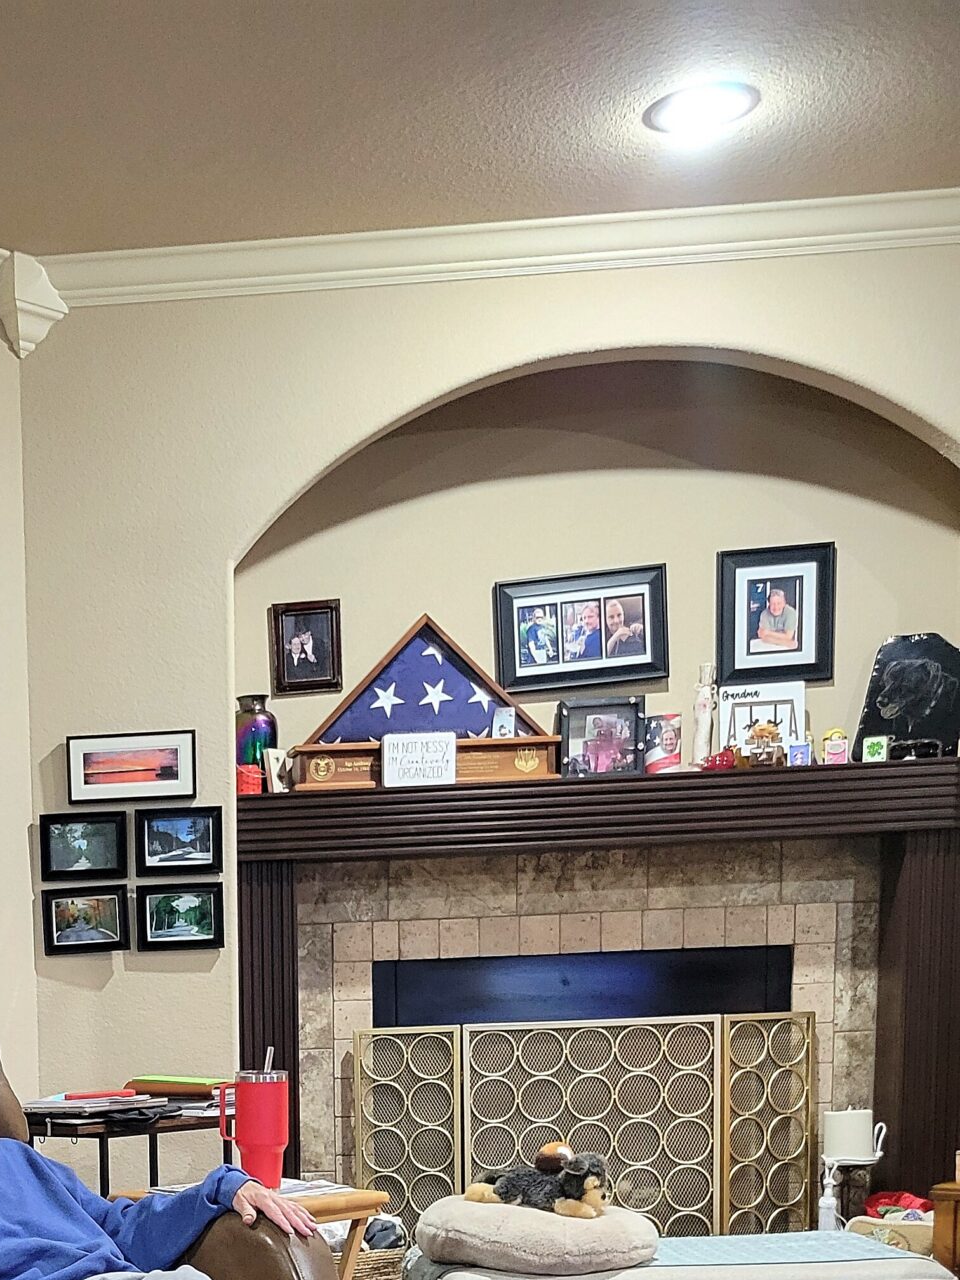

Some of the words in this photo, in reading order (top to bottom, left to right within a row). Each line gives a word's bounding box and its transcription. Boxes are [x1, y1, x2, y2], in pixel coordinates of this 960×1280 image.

[721, 689, 760, 702] Grandma
[401, 741, 419, 754] NOT
[420, 740, 450, 753] MESSY
[399, 751, 450, 771] Creatively
[397, 766, 443, 779] ORGANIZED
